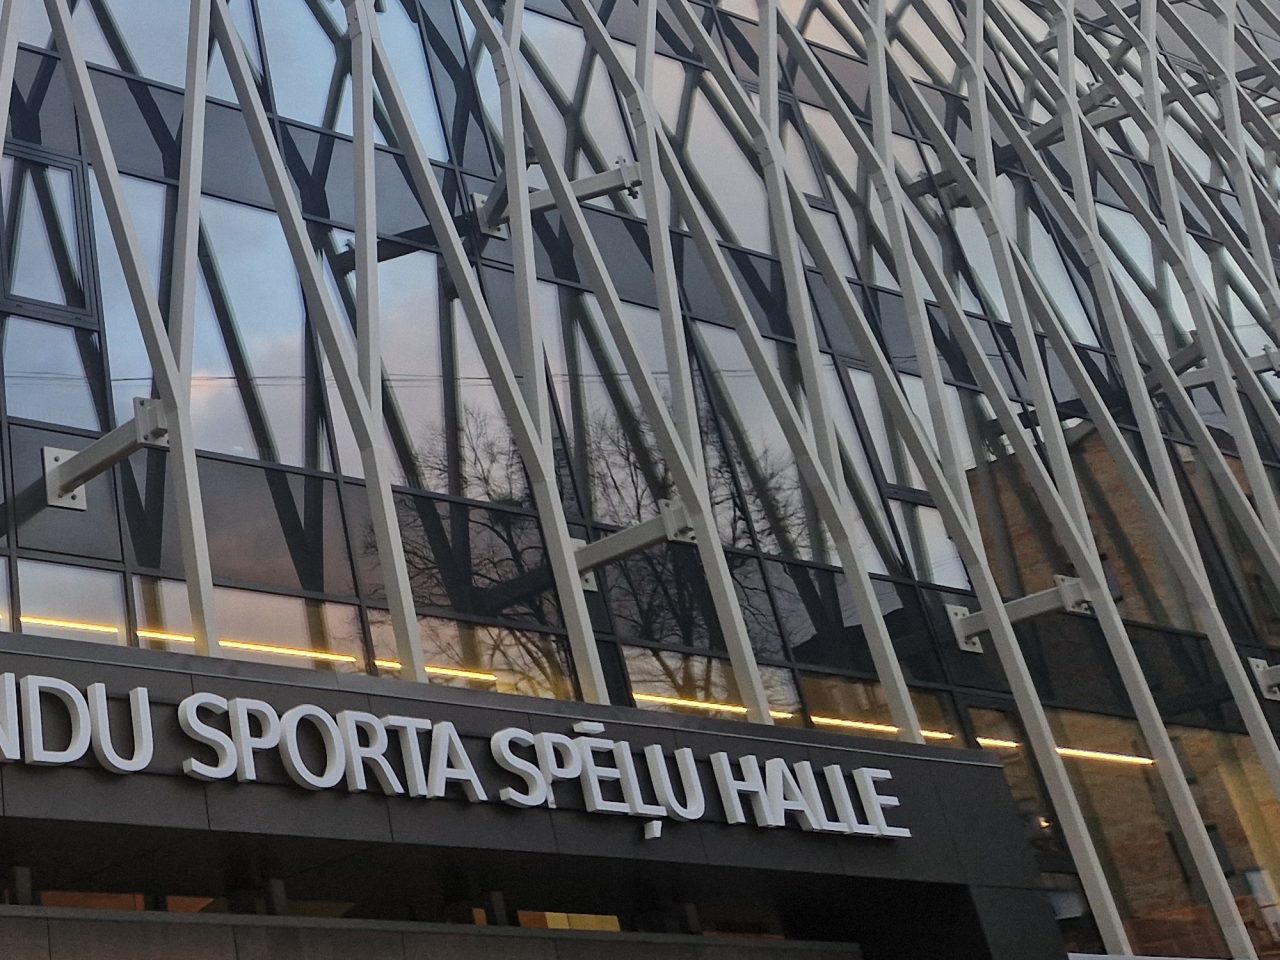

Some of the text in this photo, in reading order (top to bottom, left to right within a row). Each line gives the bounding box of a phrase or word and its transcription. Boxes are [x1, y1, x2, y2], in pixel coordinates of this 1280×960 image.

[178, 692, 488, 803] SPORTA
[490, 721, 706, 840] SPĒĻU
[710, 751, 911, 839] HALLE
